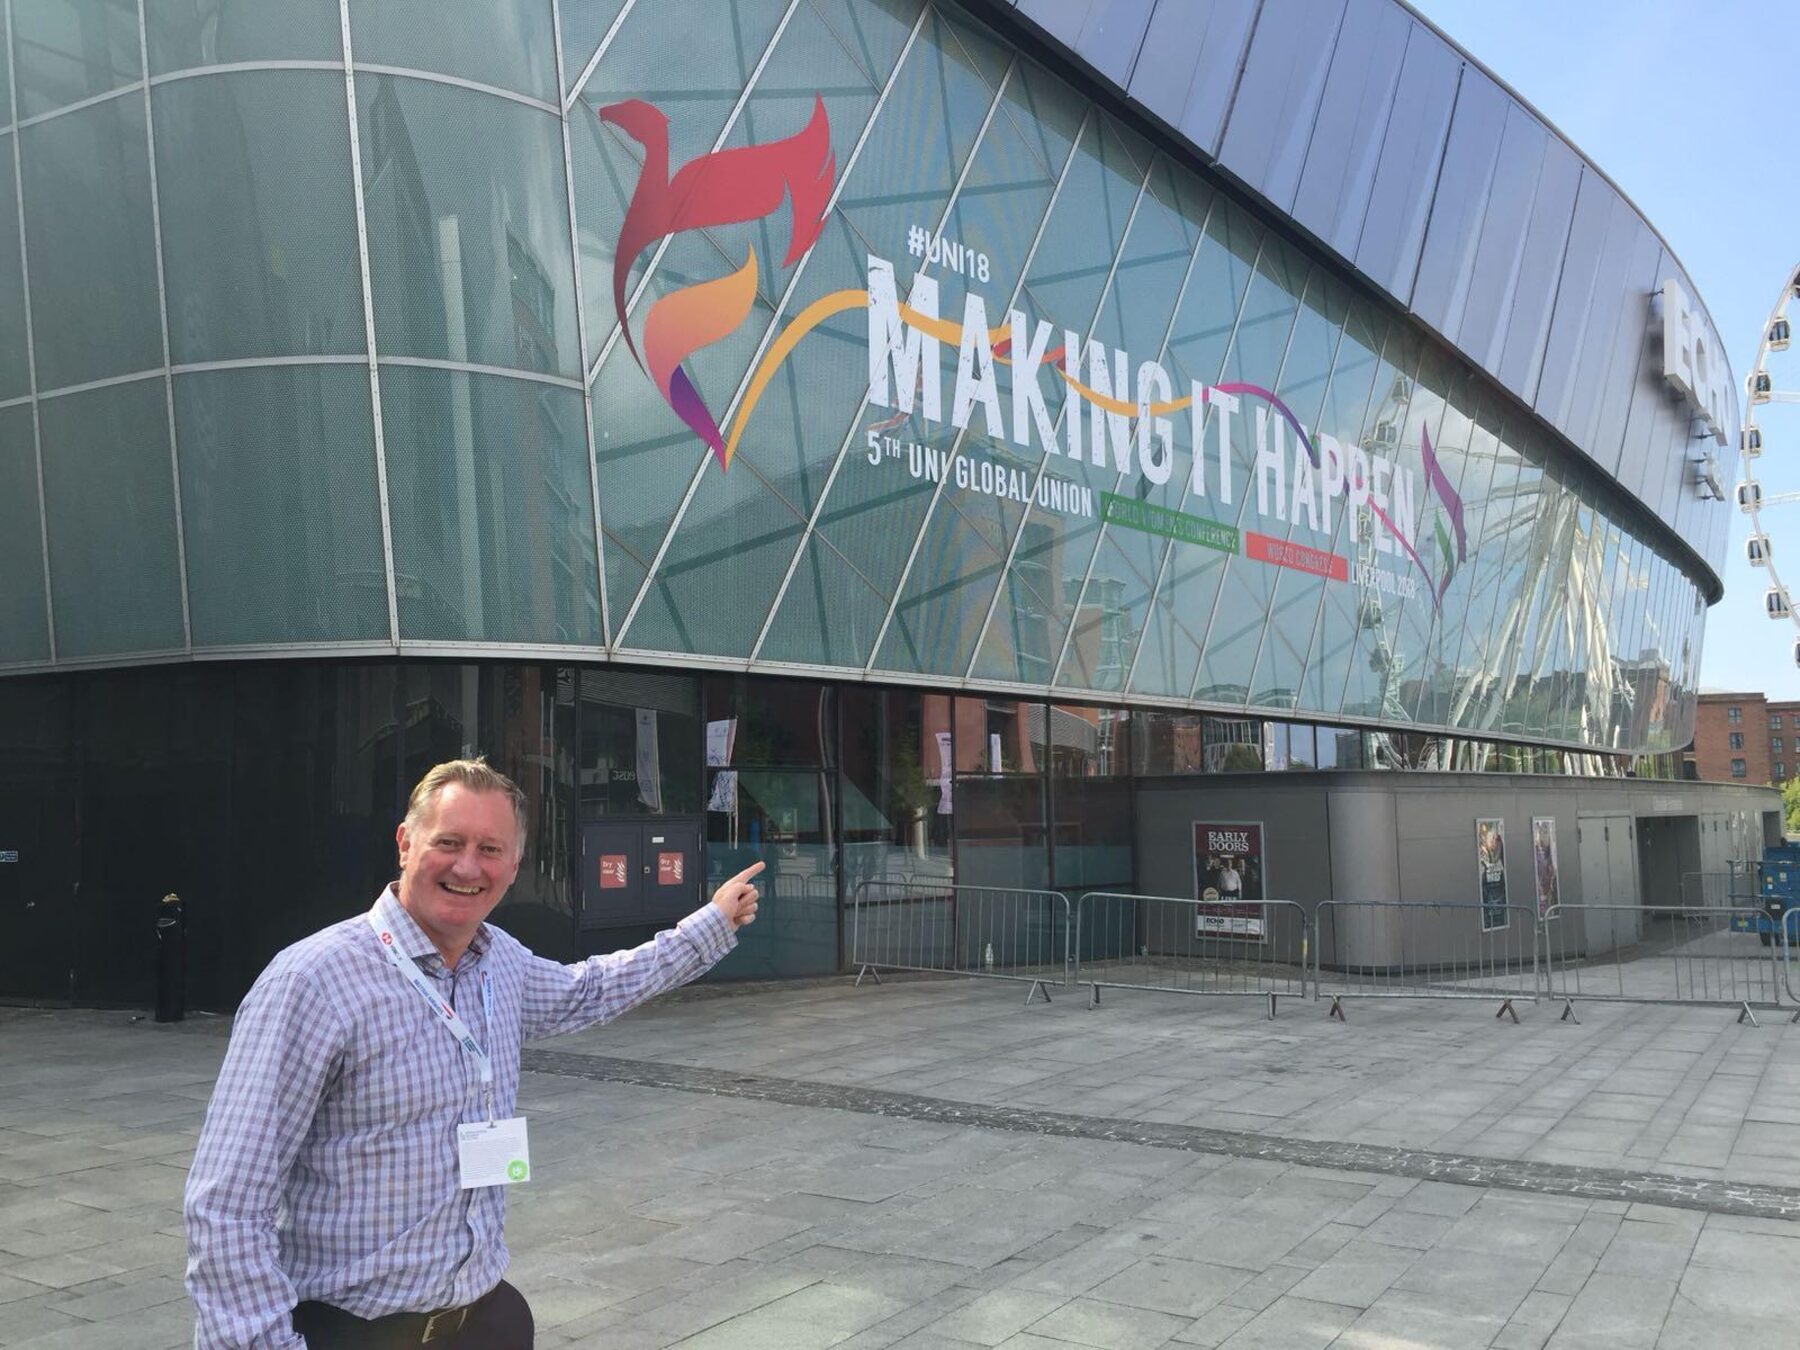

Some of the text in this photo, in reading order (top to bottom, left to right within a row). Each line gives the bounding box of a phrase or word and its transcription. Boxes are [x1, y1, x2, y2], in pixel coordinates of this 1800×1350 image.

[908, 225, 990, 283] #UNI18
[867, 253, 1415, 561] MAKING IT HAPPEN
[908, 442, 947, 484] UNI
[955, 455, 1032, 504] GLOBAL
[1037, 475, 1092, 518] UNION
[1208, 831, 1248, 842] EARLY
[1208, 842, 1249, 852] DOORS
